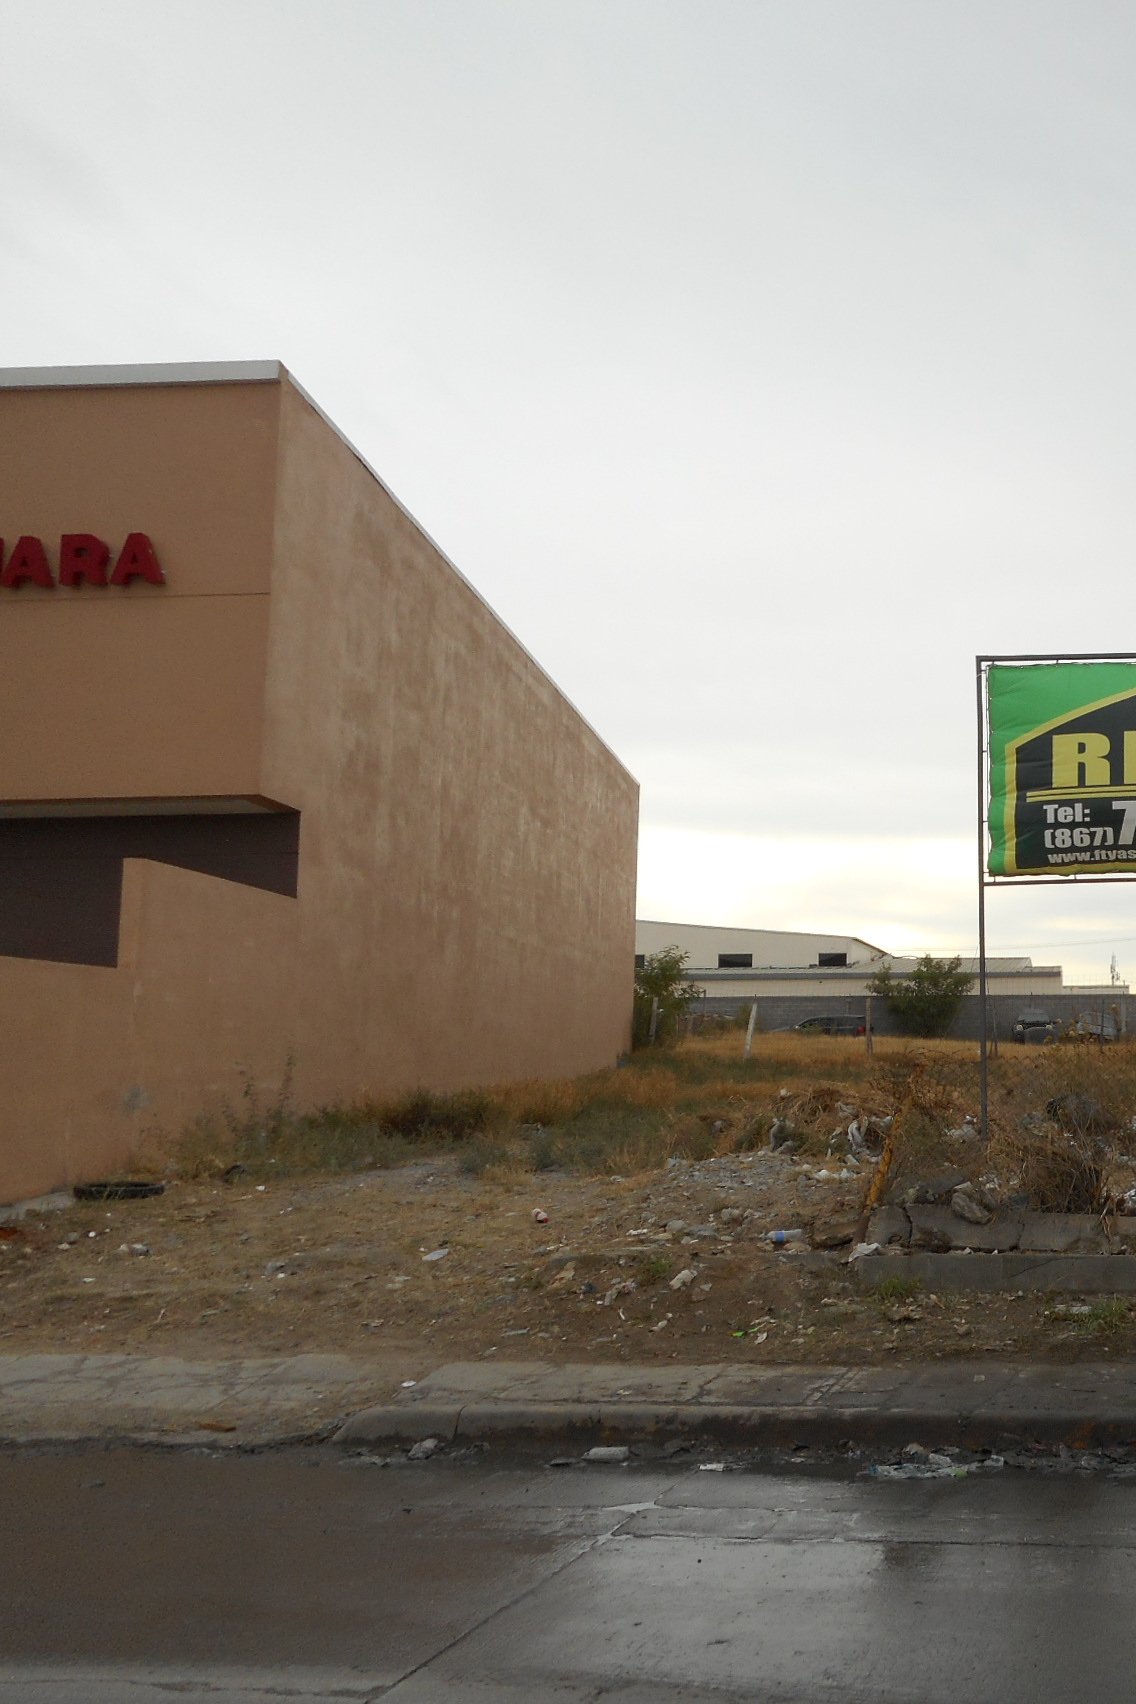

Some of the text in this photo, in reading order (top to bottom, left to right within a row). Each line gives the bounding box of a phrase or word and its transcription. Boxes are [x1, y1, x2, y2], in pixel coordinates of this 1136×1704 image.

[0, 532, 166, 589] ARA
[1043, 803, 1091, 824] Tel:
[1044, 826, 1114, 849] (867)
